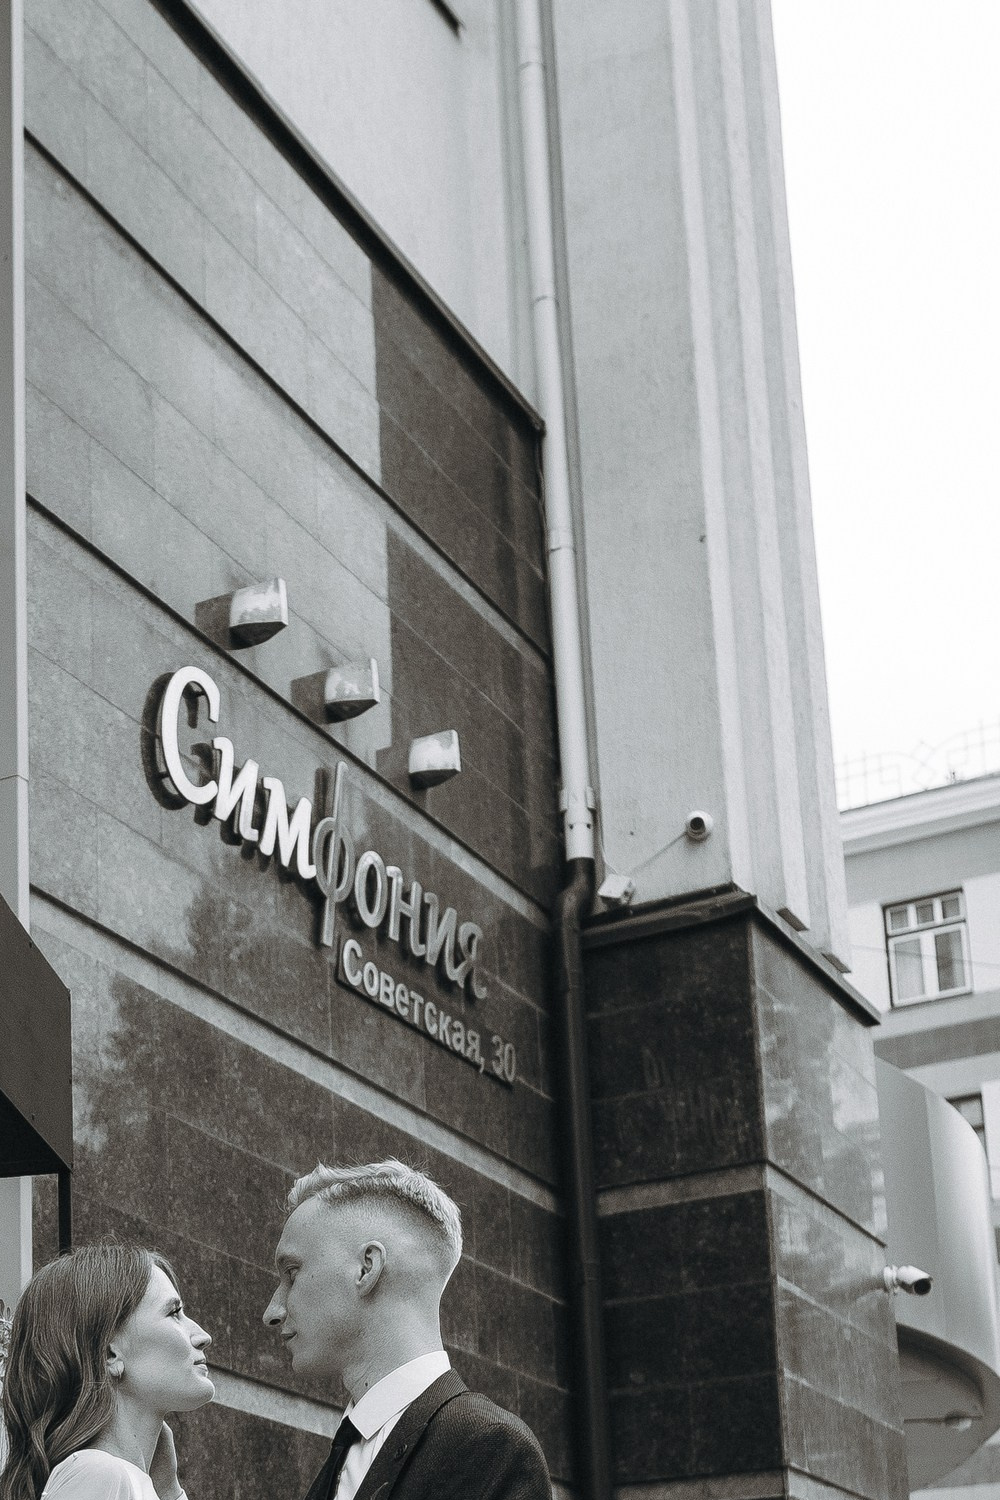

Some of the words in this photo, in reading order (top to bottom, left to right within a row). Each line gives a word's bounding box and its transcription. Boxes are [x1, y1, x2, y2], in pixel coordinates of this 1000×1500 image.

[162, 665, 487, 999] Симфония
[342, 938, 485, 1073] Советская,
[491, 1034, 517, 1083] 30
